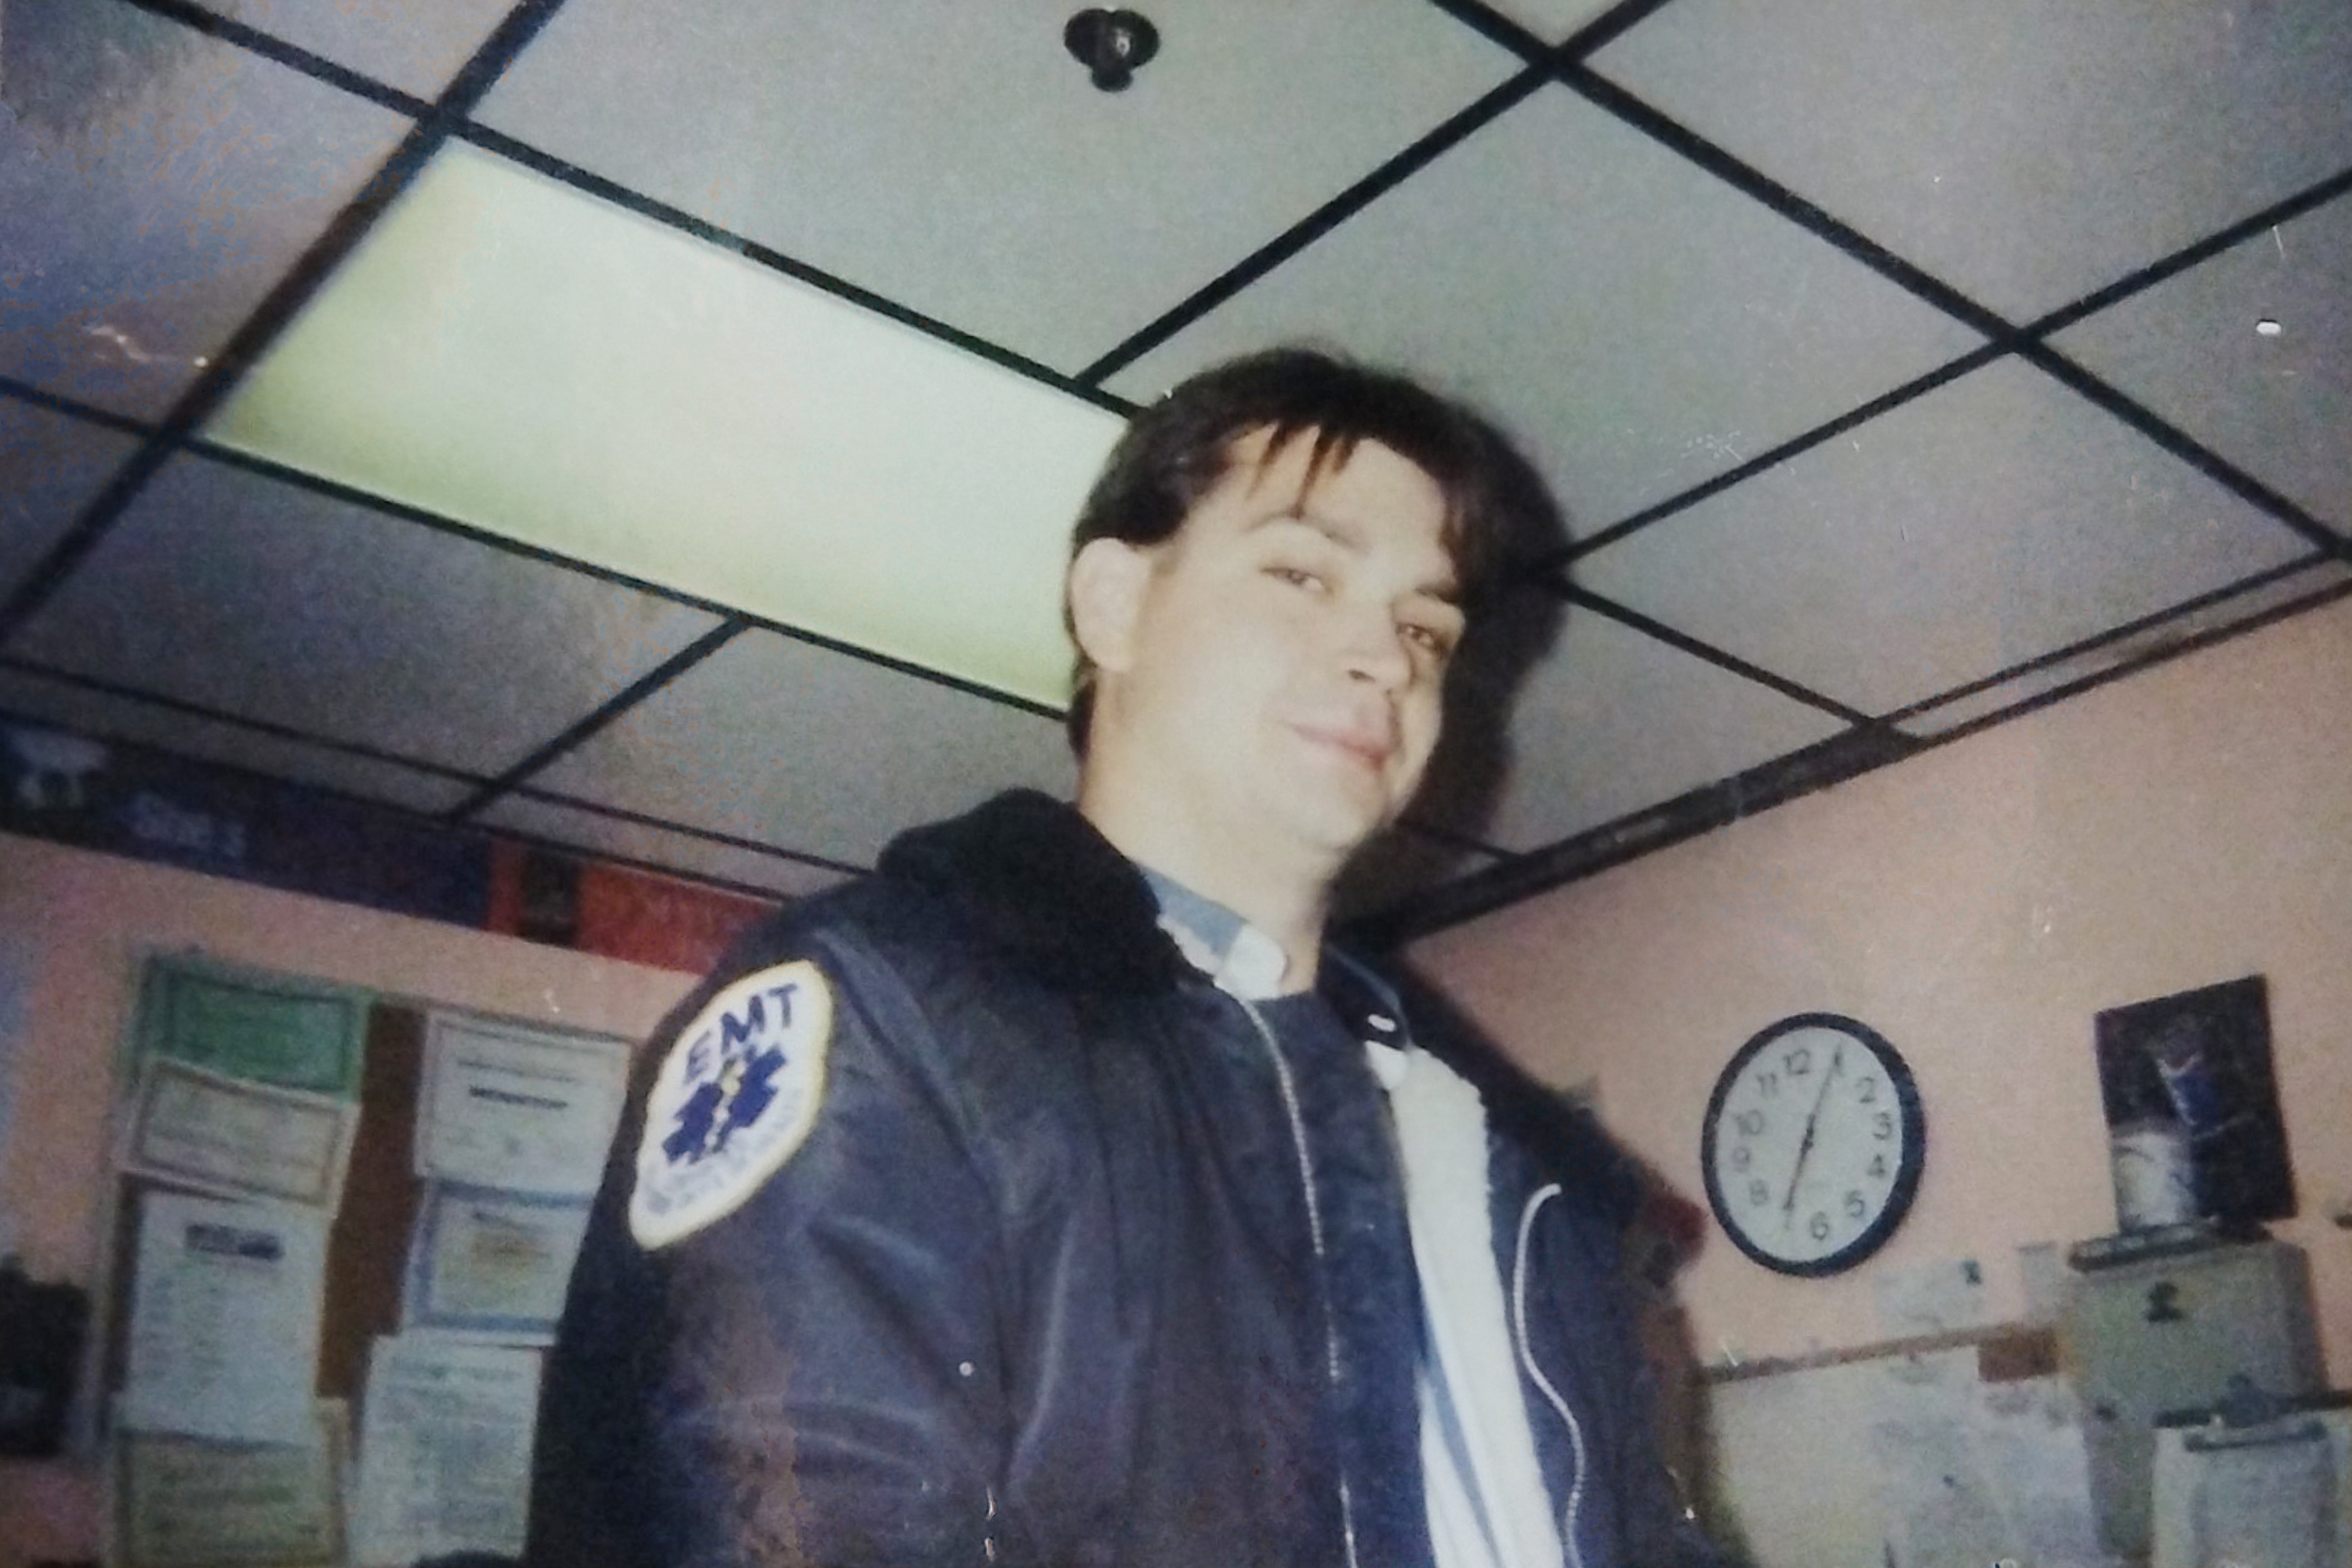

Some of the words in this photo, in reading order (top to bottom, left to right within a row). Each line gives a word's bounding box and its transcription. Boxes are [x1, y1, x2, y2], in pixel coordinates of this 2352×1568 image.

[685, 982, 798, 1085] EMT
[1784, 1048, 1810, 1075] 12
[1756, 1072, 1777, 1094] 11
[1855, 1076, 1876, 1103] 2
[1733, 1109, 1764, 1136] 10
[1872, 1112, 1892, 1140] 3
[1733, 1146, 1751, 1173] 9
[1867, 1153, 1886, 1178] 4
[1749, 1178, 1769, 1206] 8
[1845, 1190, 1865, 1218] 5
[1810, 1211, 1830, 1240] 6
